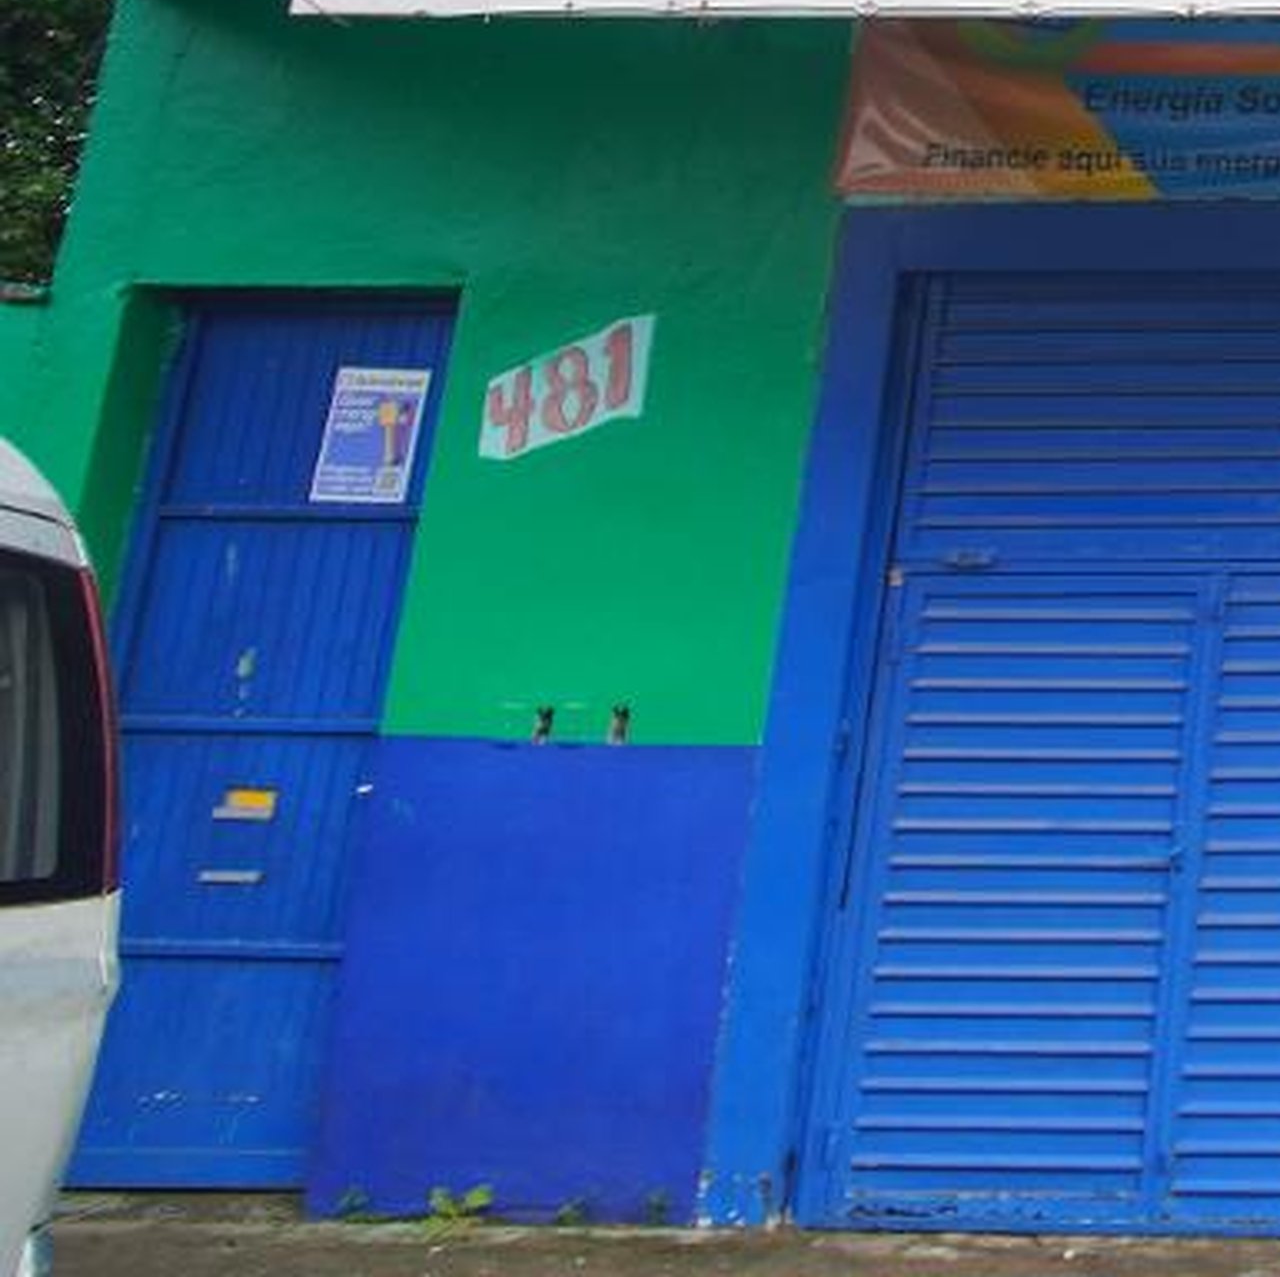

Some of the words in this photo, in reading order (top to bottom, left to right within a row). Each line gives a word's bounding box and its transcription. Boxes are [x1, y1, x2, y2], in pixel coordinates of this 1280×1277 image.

[1083, 85, 1224, 120] Energia
[923, 143, 1050, 168] Financie
[1059, 145, 1122, 175] aqui
[488, 321, 633, 456] 481
